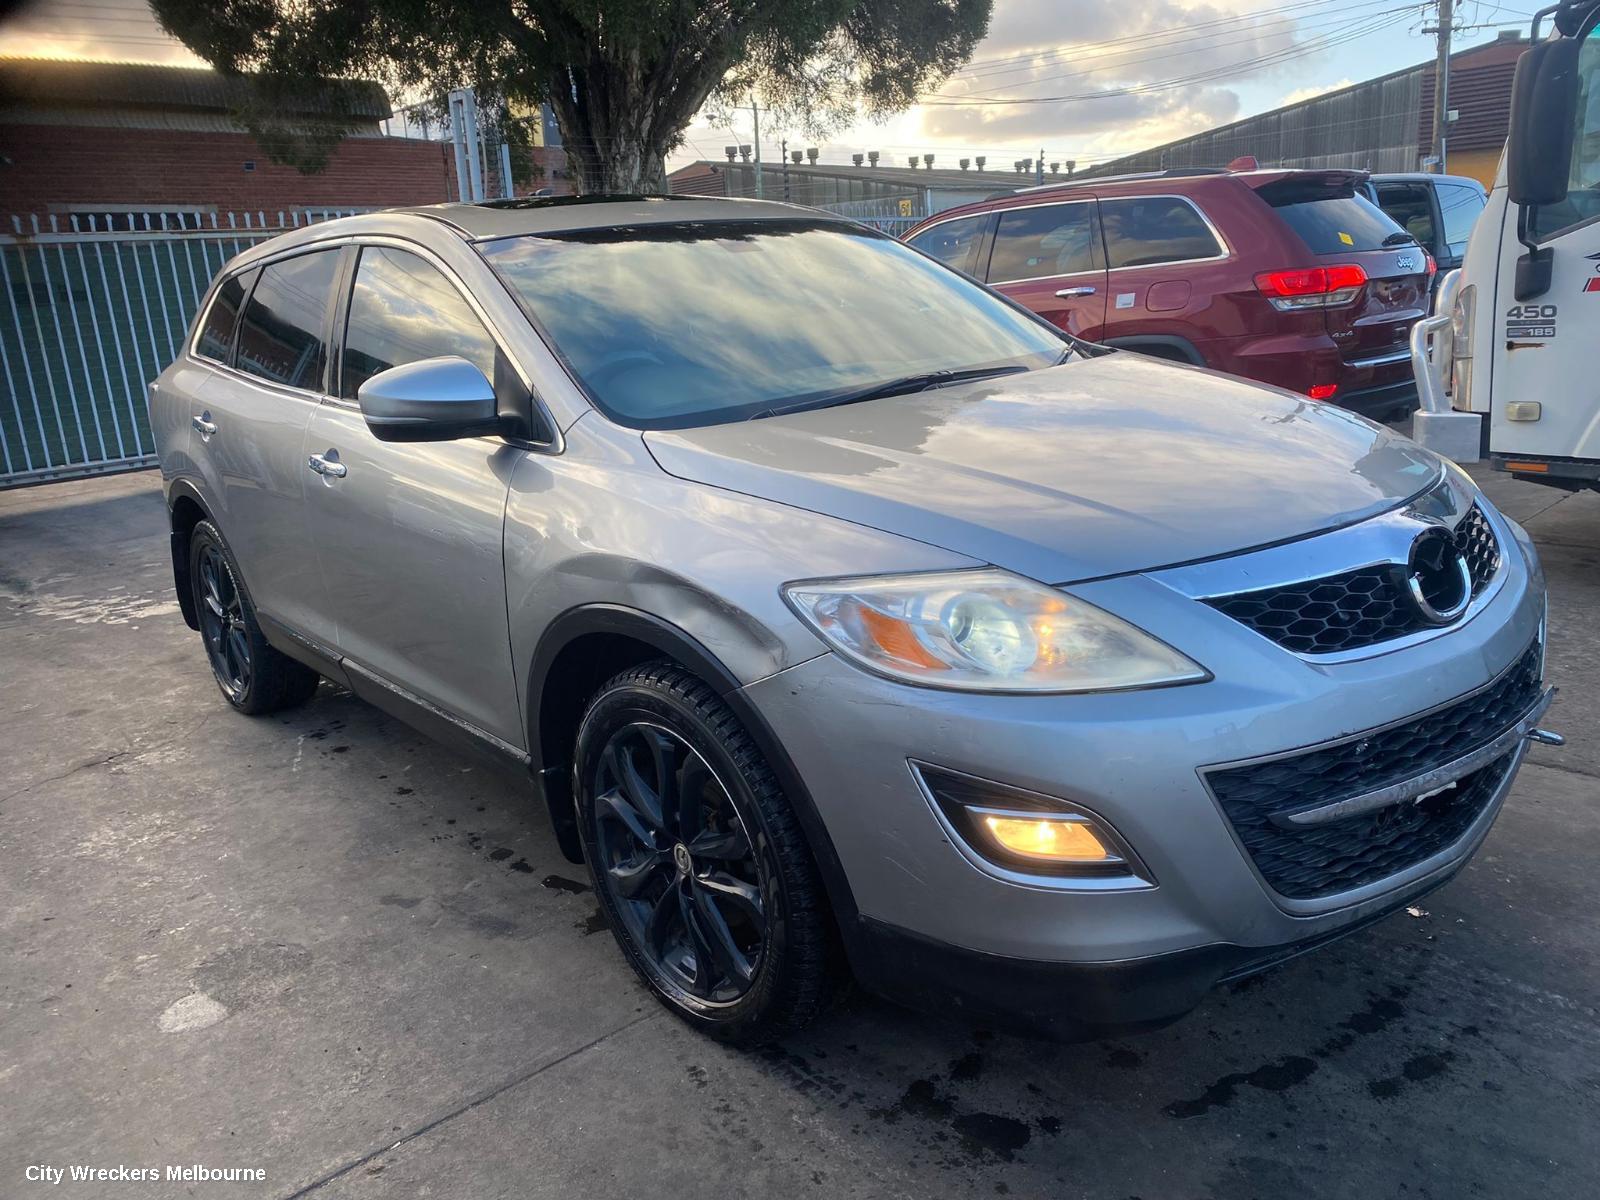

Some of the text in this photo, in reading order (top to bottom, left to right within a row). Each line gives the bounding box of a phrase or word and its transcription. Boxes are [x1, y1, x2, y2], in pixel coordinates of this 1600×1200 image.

[1397, 256, 1414, 270] Jeep
[1506, 304, 1557, 319] 450
[1527, 328, 1554, 336] 185
